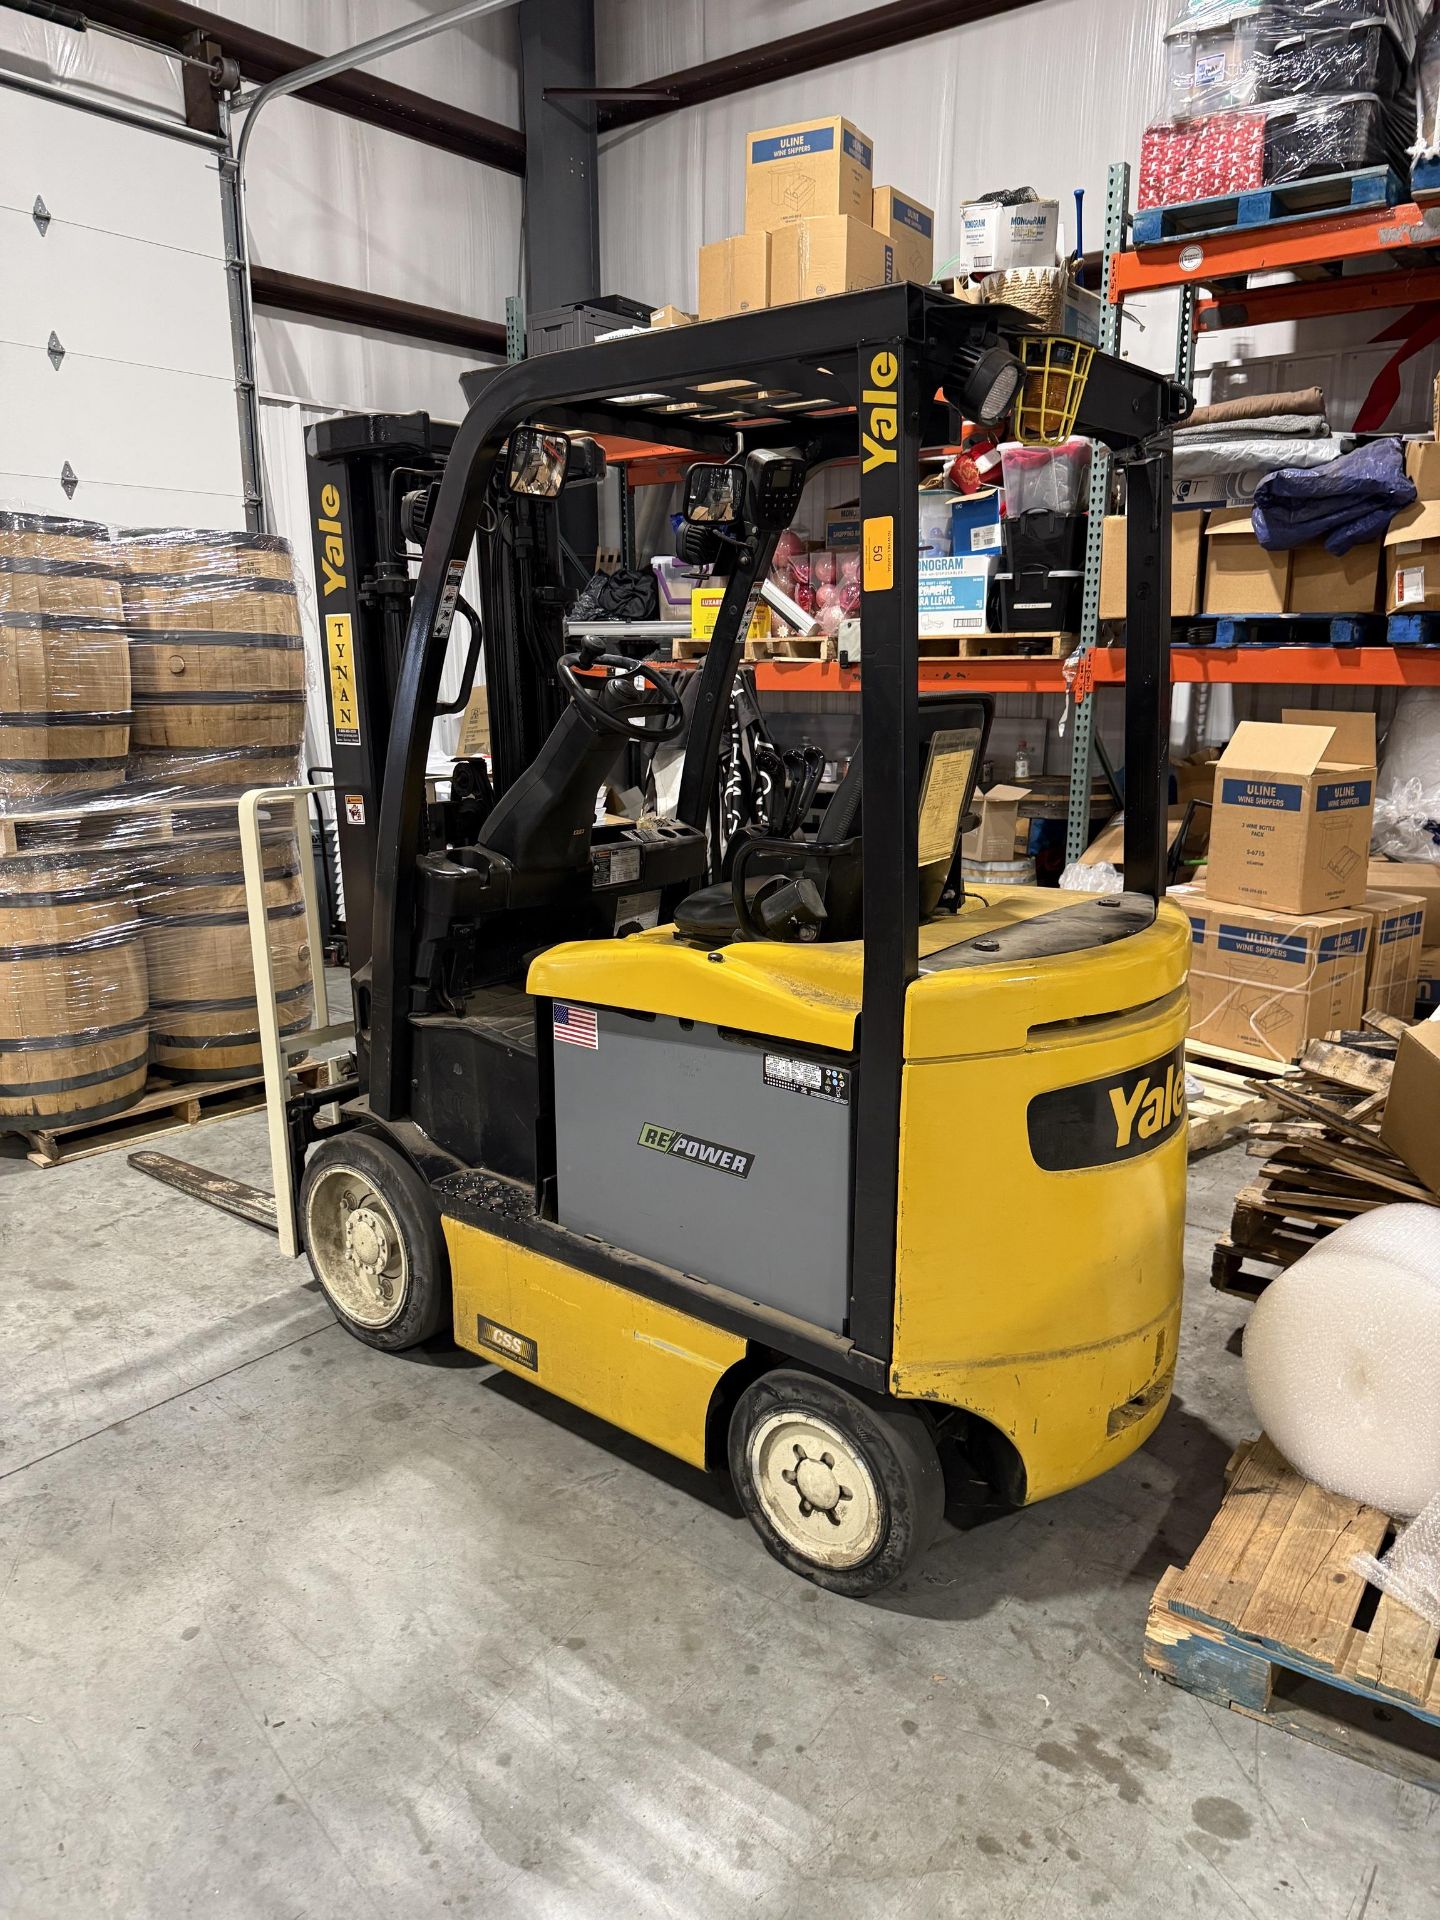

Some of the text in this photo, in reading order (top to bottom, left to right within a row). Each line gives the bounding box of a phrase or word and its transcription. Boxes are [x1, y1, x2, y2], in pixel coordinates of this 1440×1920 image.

[780, 136, 804, 149] ULINE
[773, 145, 811, 157] WINE SHIPPERS
[862, 351, 898, 475] Yale
[318, 484, 347, 597] Yale
[873, 545, 883, 562] 50
[930, 595, 956, 606] LLEVAR
[334, 623, 352, 723] TYNAN
[1247, 784, 1277, 797] ULINE
[1334, 786, 1356, 798] ULINE
[1237, 795, 1285, 807] WINE SHIPPERS
[1246, 932, 1279, 945] ULINE
[1236, 942, 1287, 958] WINE SHIPPERS
[1108, 1063, 1184, 1148] Yale
[492, 1329, 522, 1353] CSS
